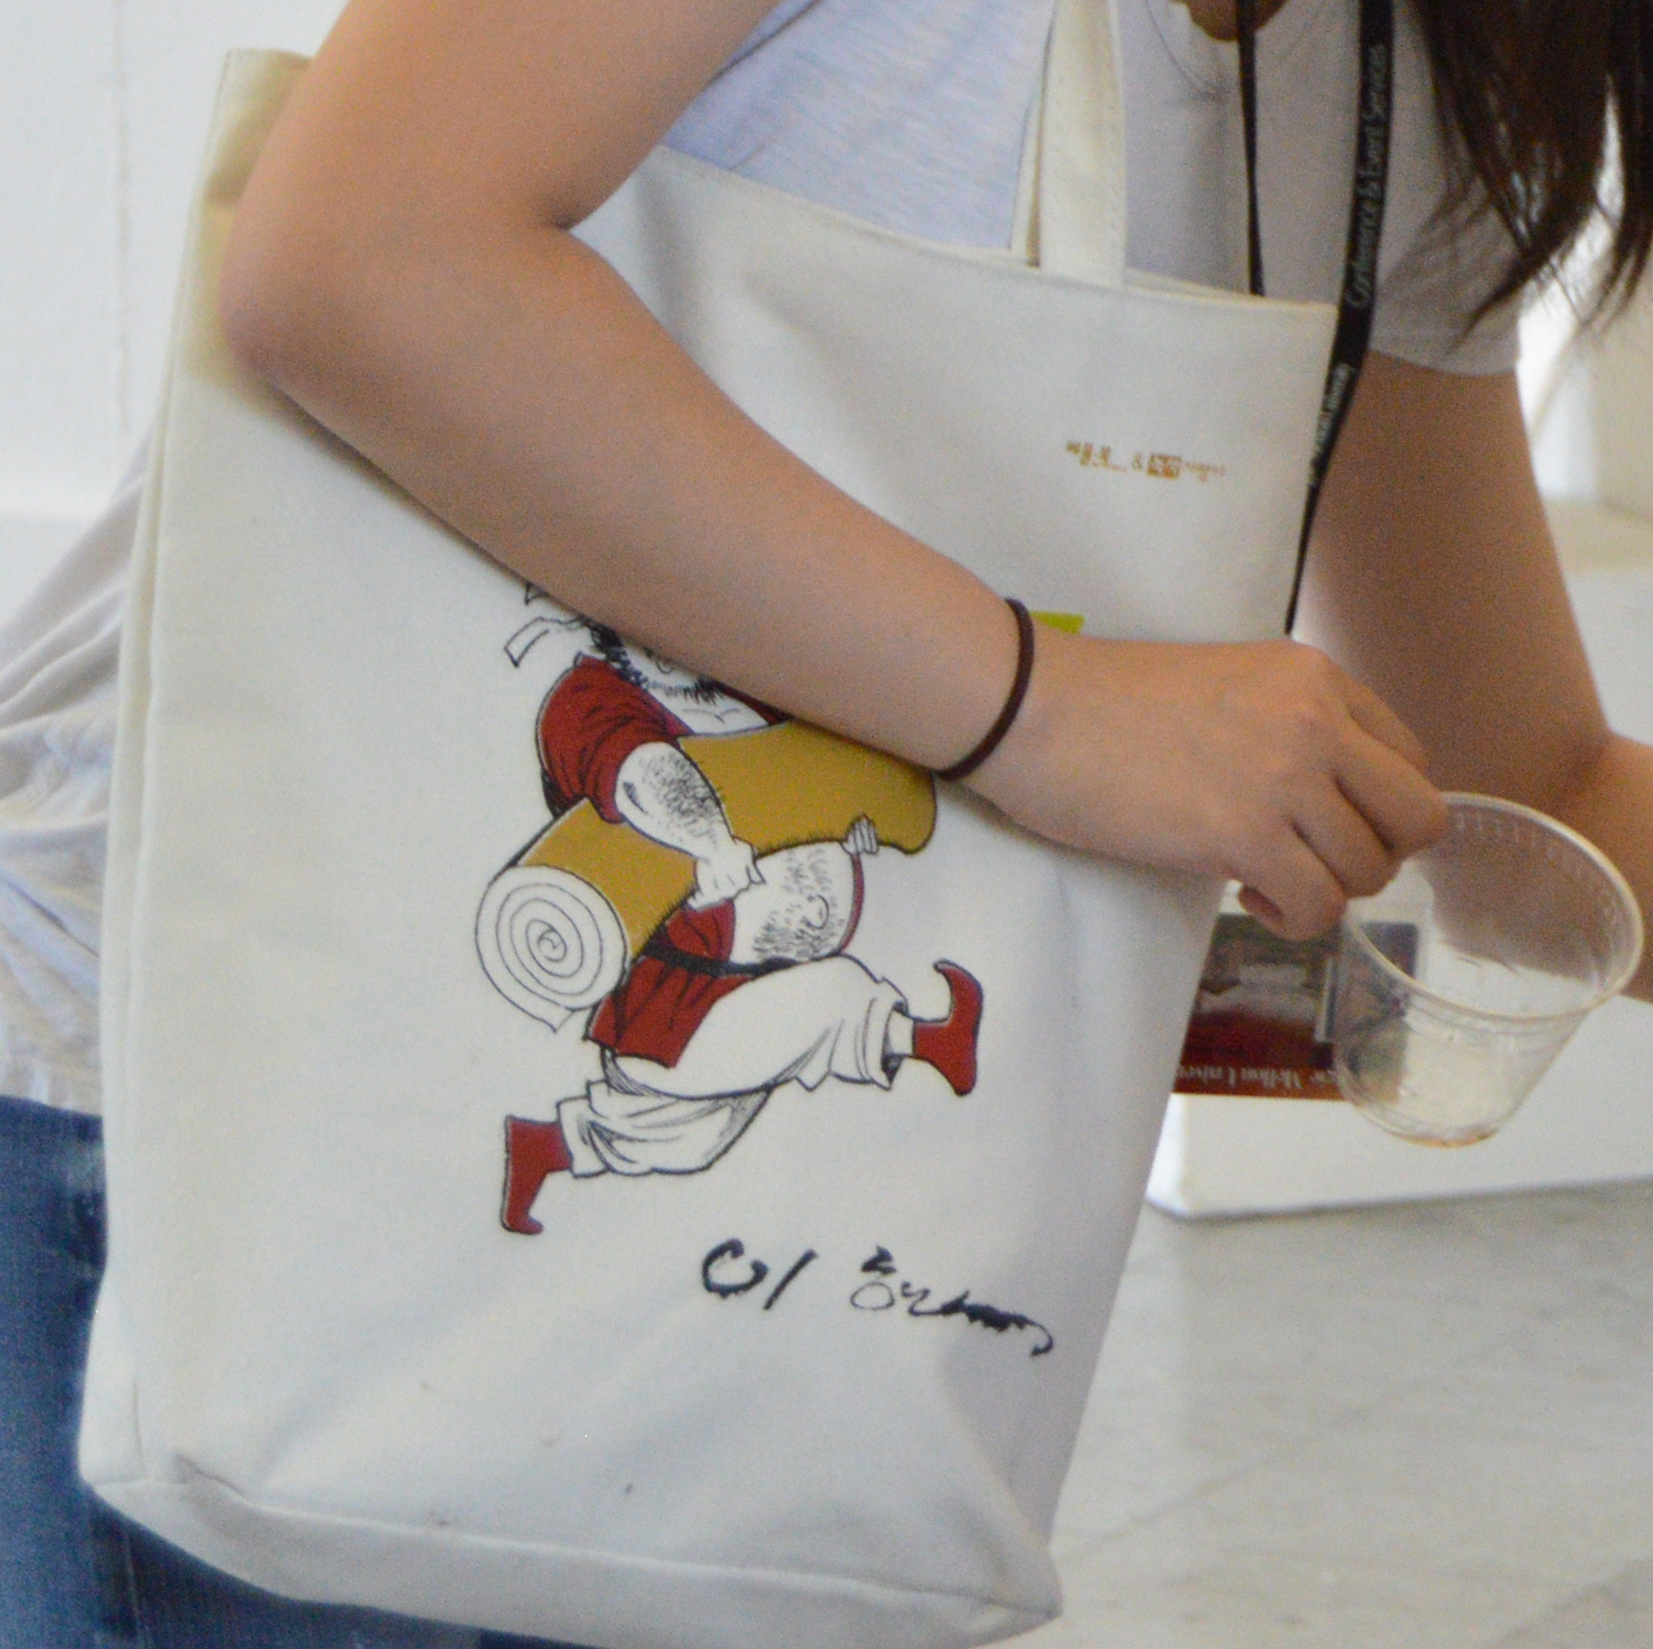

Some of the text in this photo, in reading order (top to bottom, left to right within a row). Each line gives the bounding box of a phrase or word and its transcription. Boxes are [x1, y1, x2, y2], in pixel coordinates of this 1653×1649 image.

[1361, 43, 1388, 122] Services
[1357, 127, 1384, 179] Event
[1344, 203, 1377, 309] Conference
